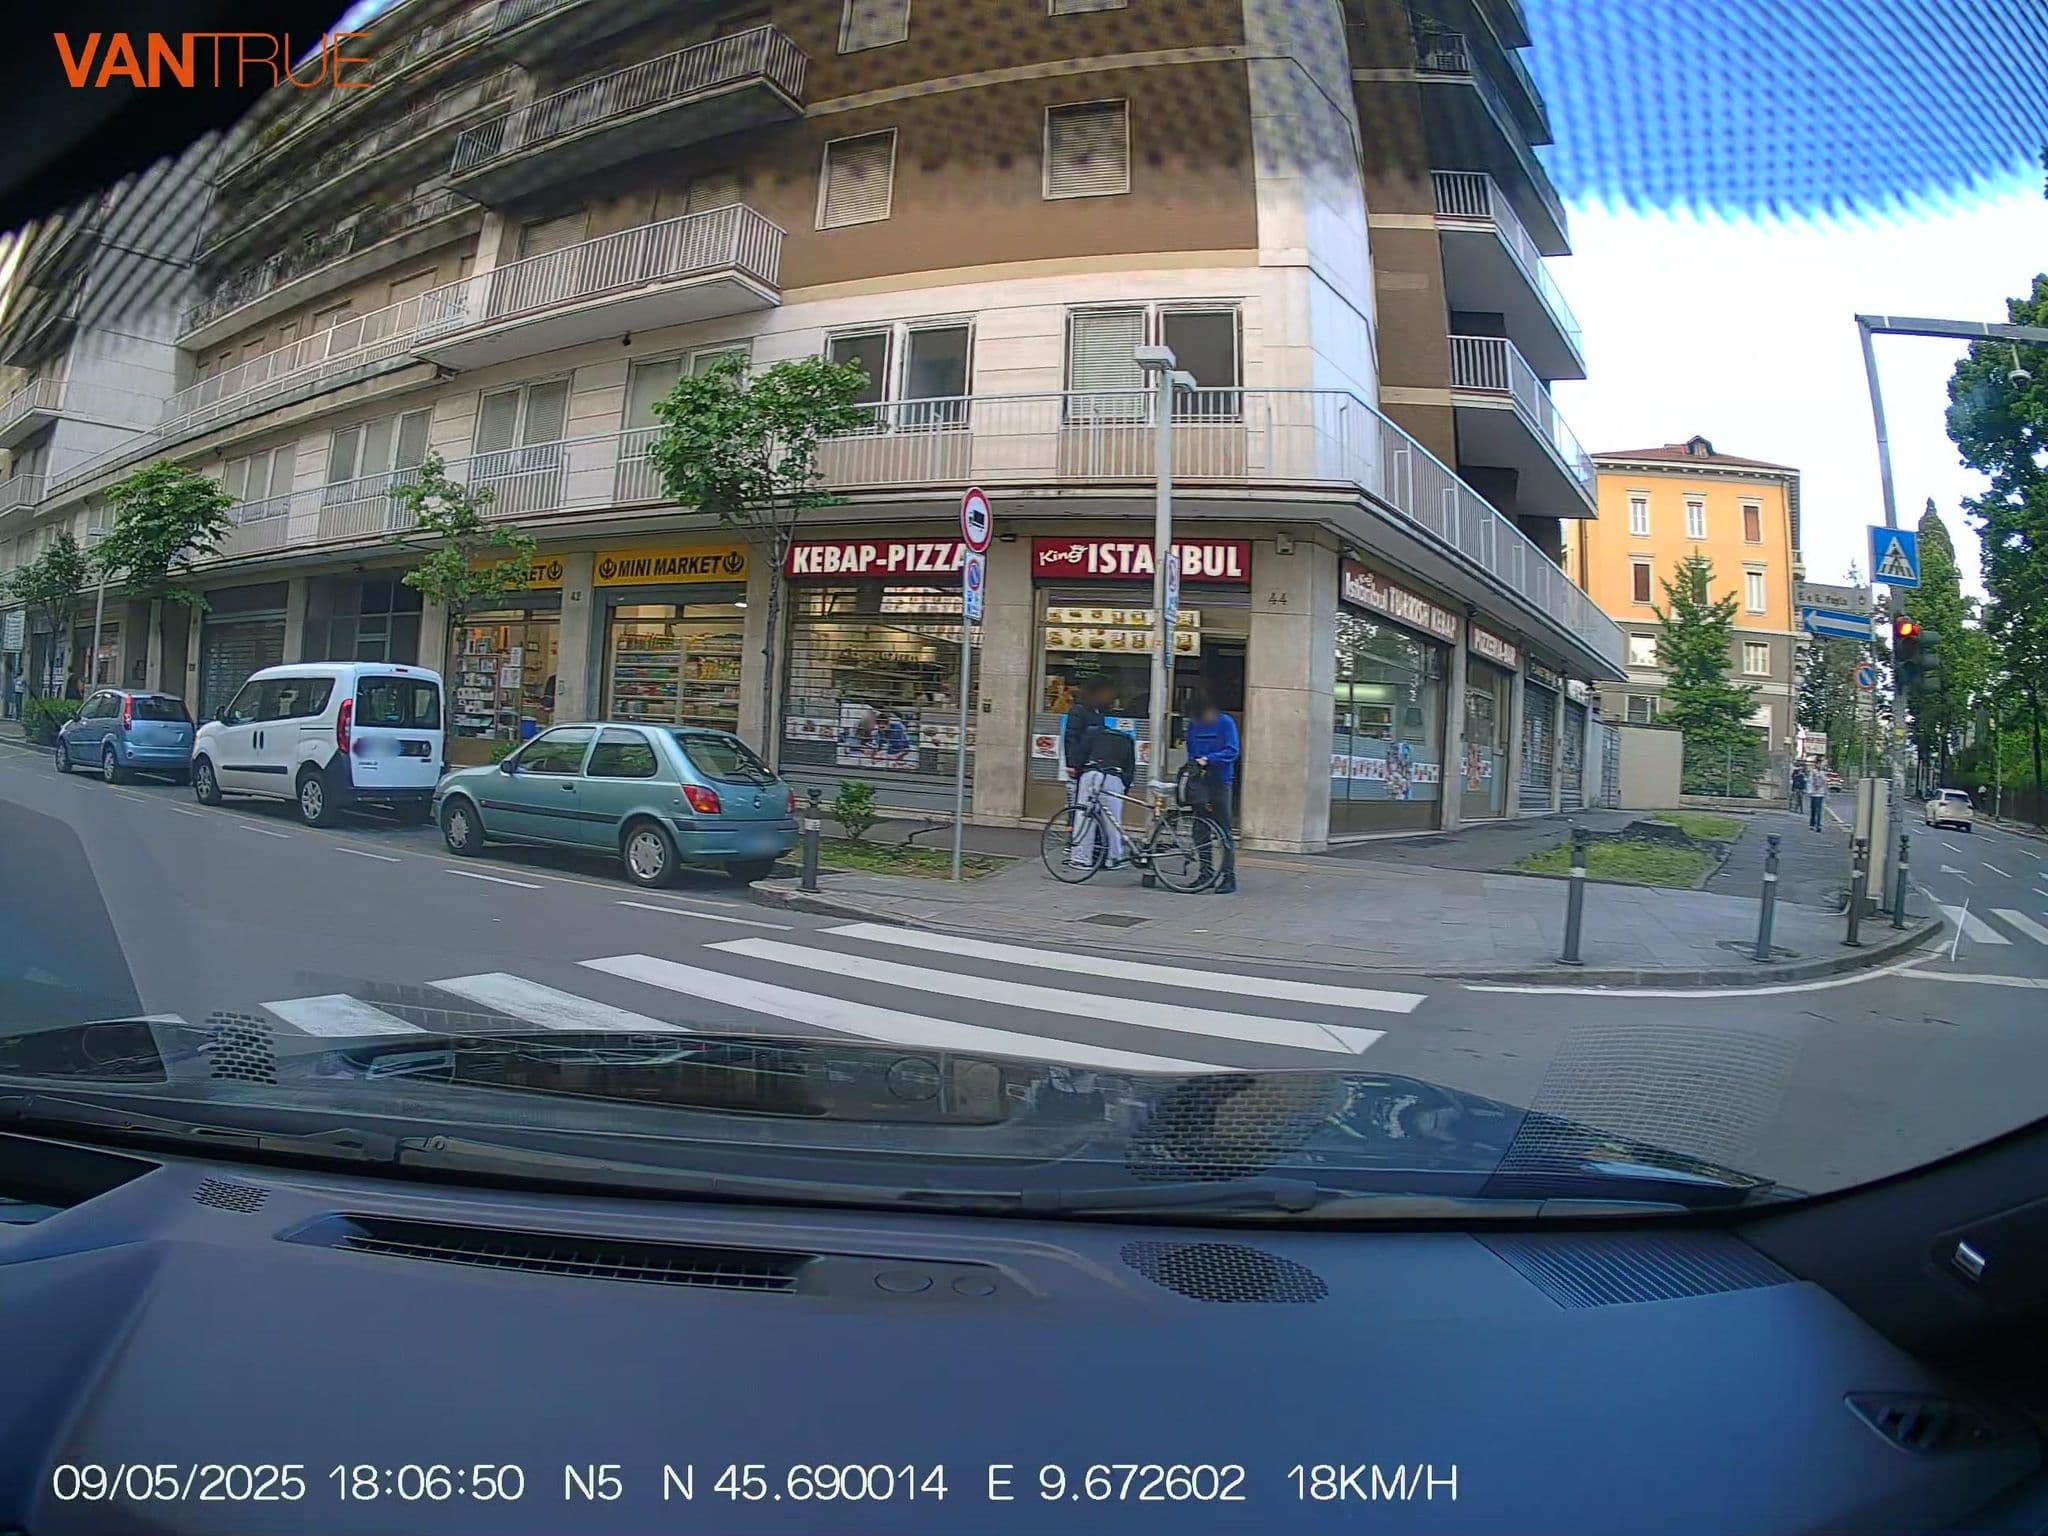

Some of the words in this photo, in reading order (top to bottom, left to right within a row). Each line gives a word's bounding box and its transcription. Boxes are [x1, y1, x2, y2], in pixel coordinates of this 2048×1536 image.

[618, 558, 650, 577] MINI
[653, 555, 722, 576] MARKET
[1039, 549, 1083, 567] King
[1087, 543, 1242, 577] ISTABUL
[1268, 592, 1287, 606] 44
